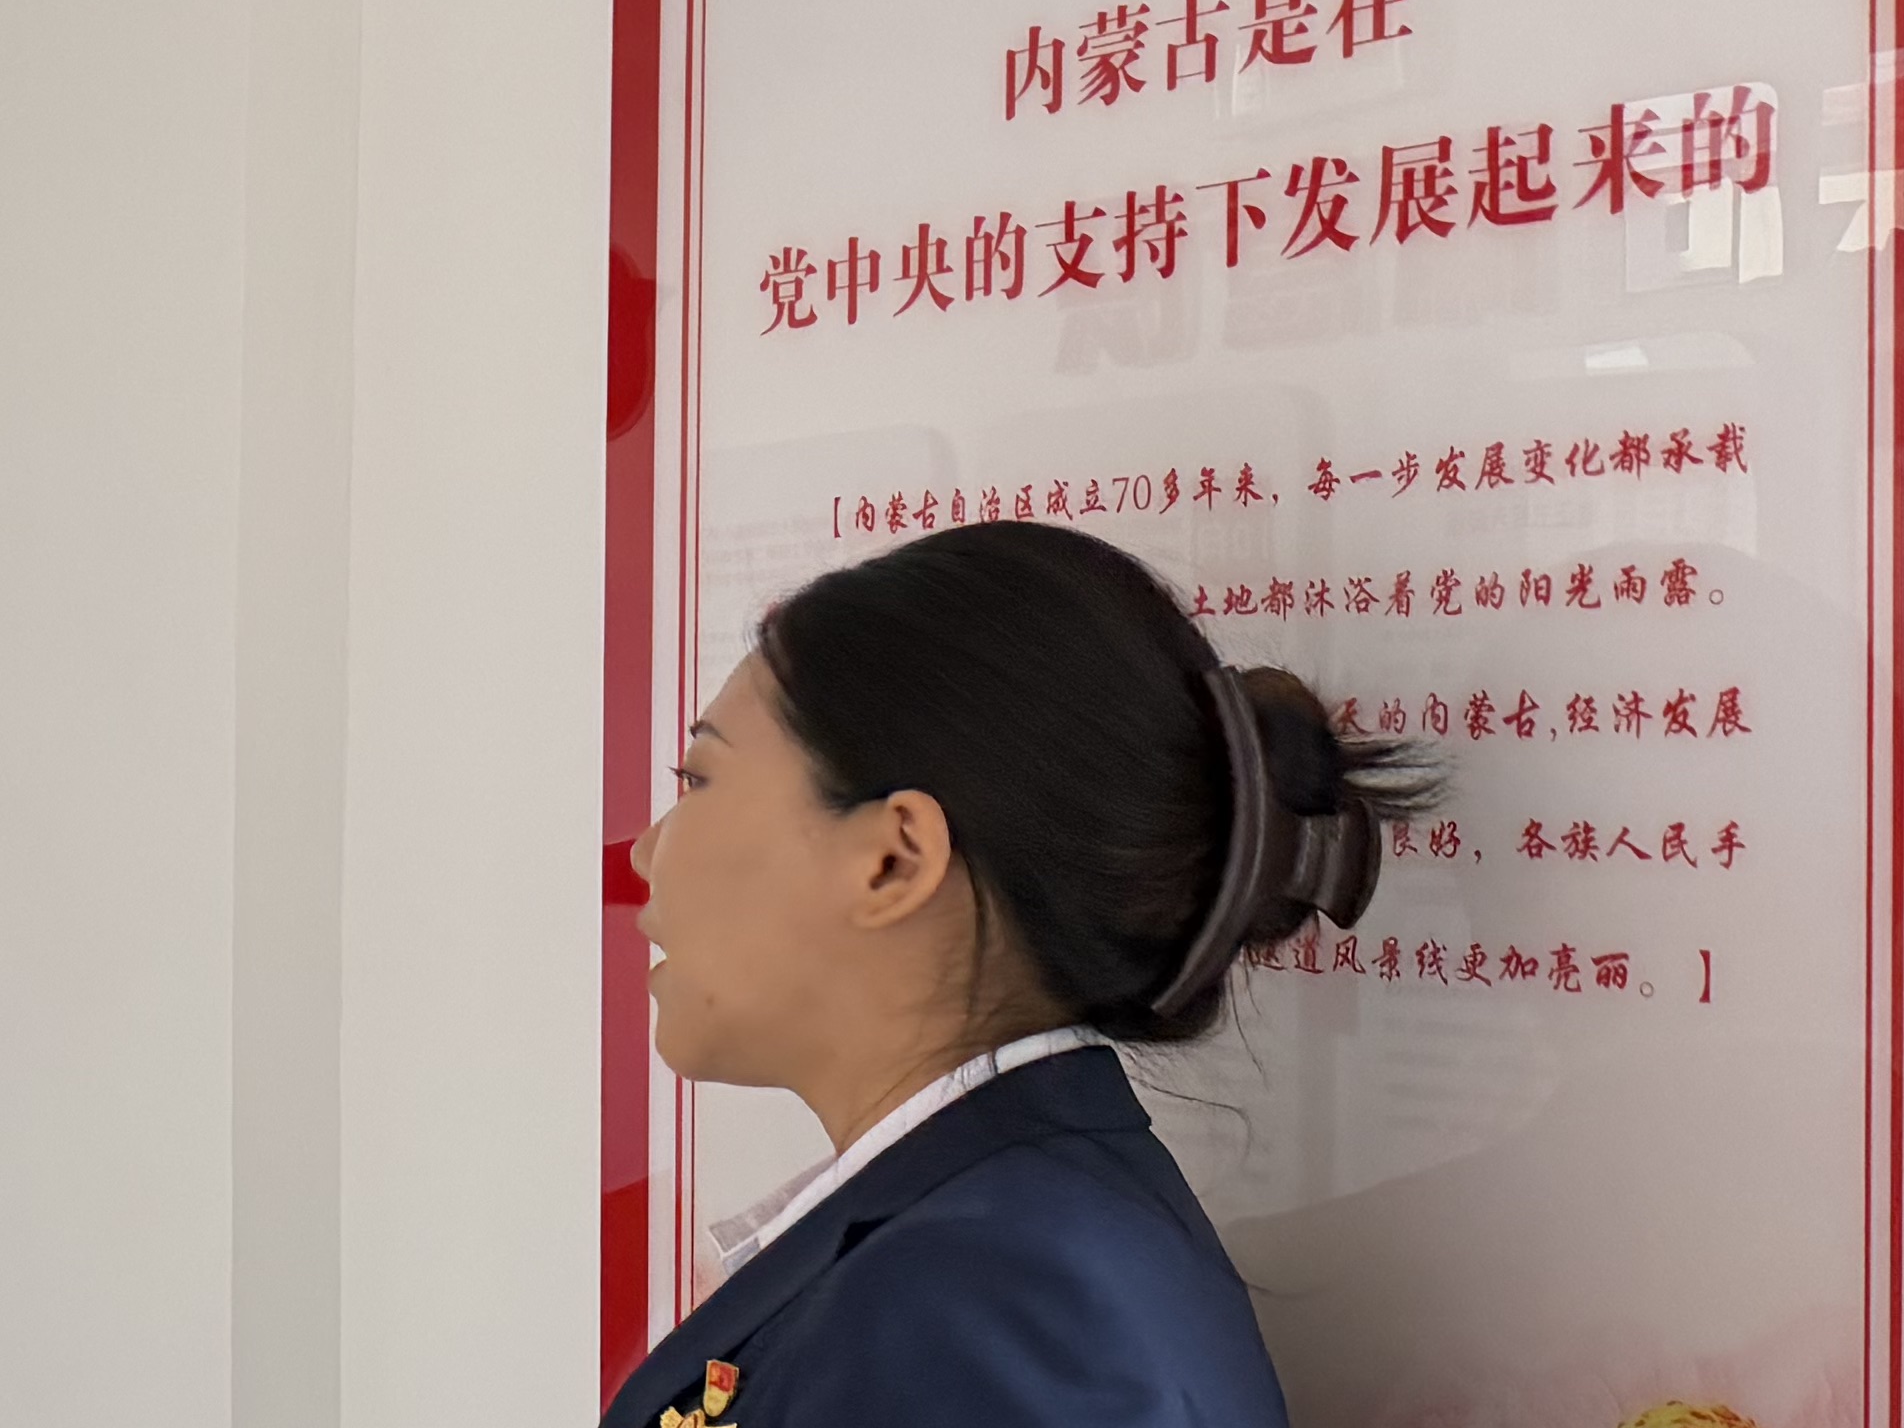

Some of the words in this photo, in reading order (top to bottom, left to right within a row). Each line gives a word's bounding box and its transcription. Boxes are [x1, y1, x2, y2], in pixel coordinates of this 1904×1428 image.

[758, 85, 1776, 336] 党中央的支持下发展起来的
